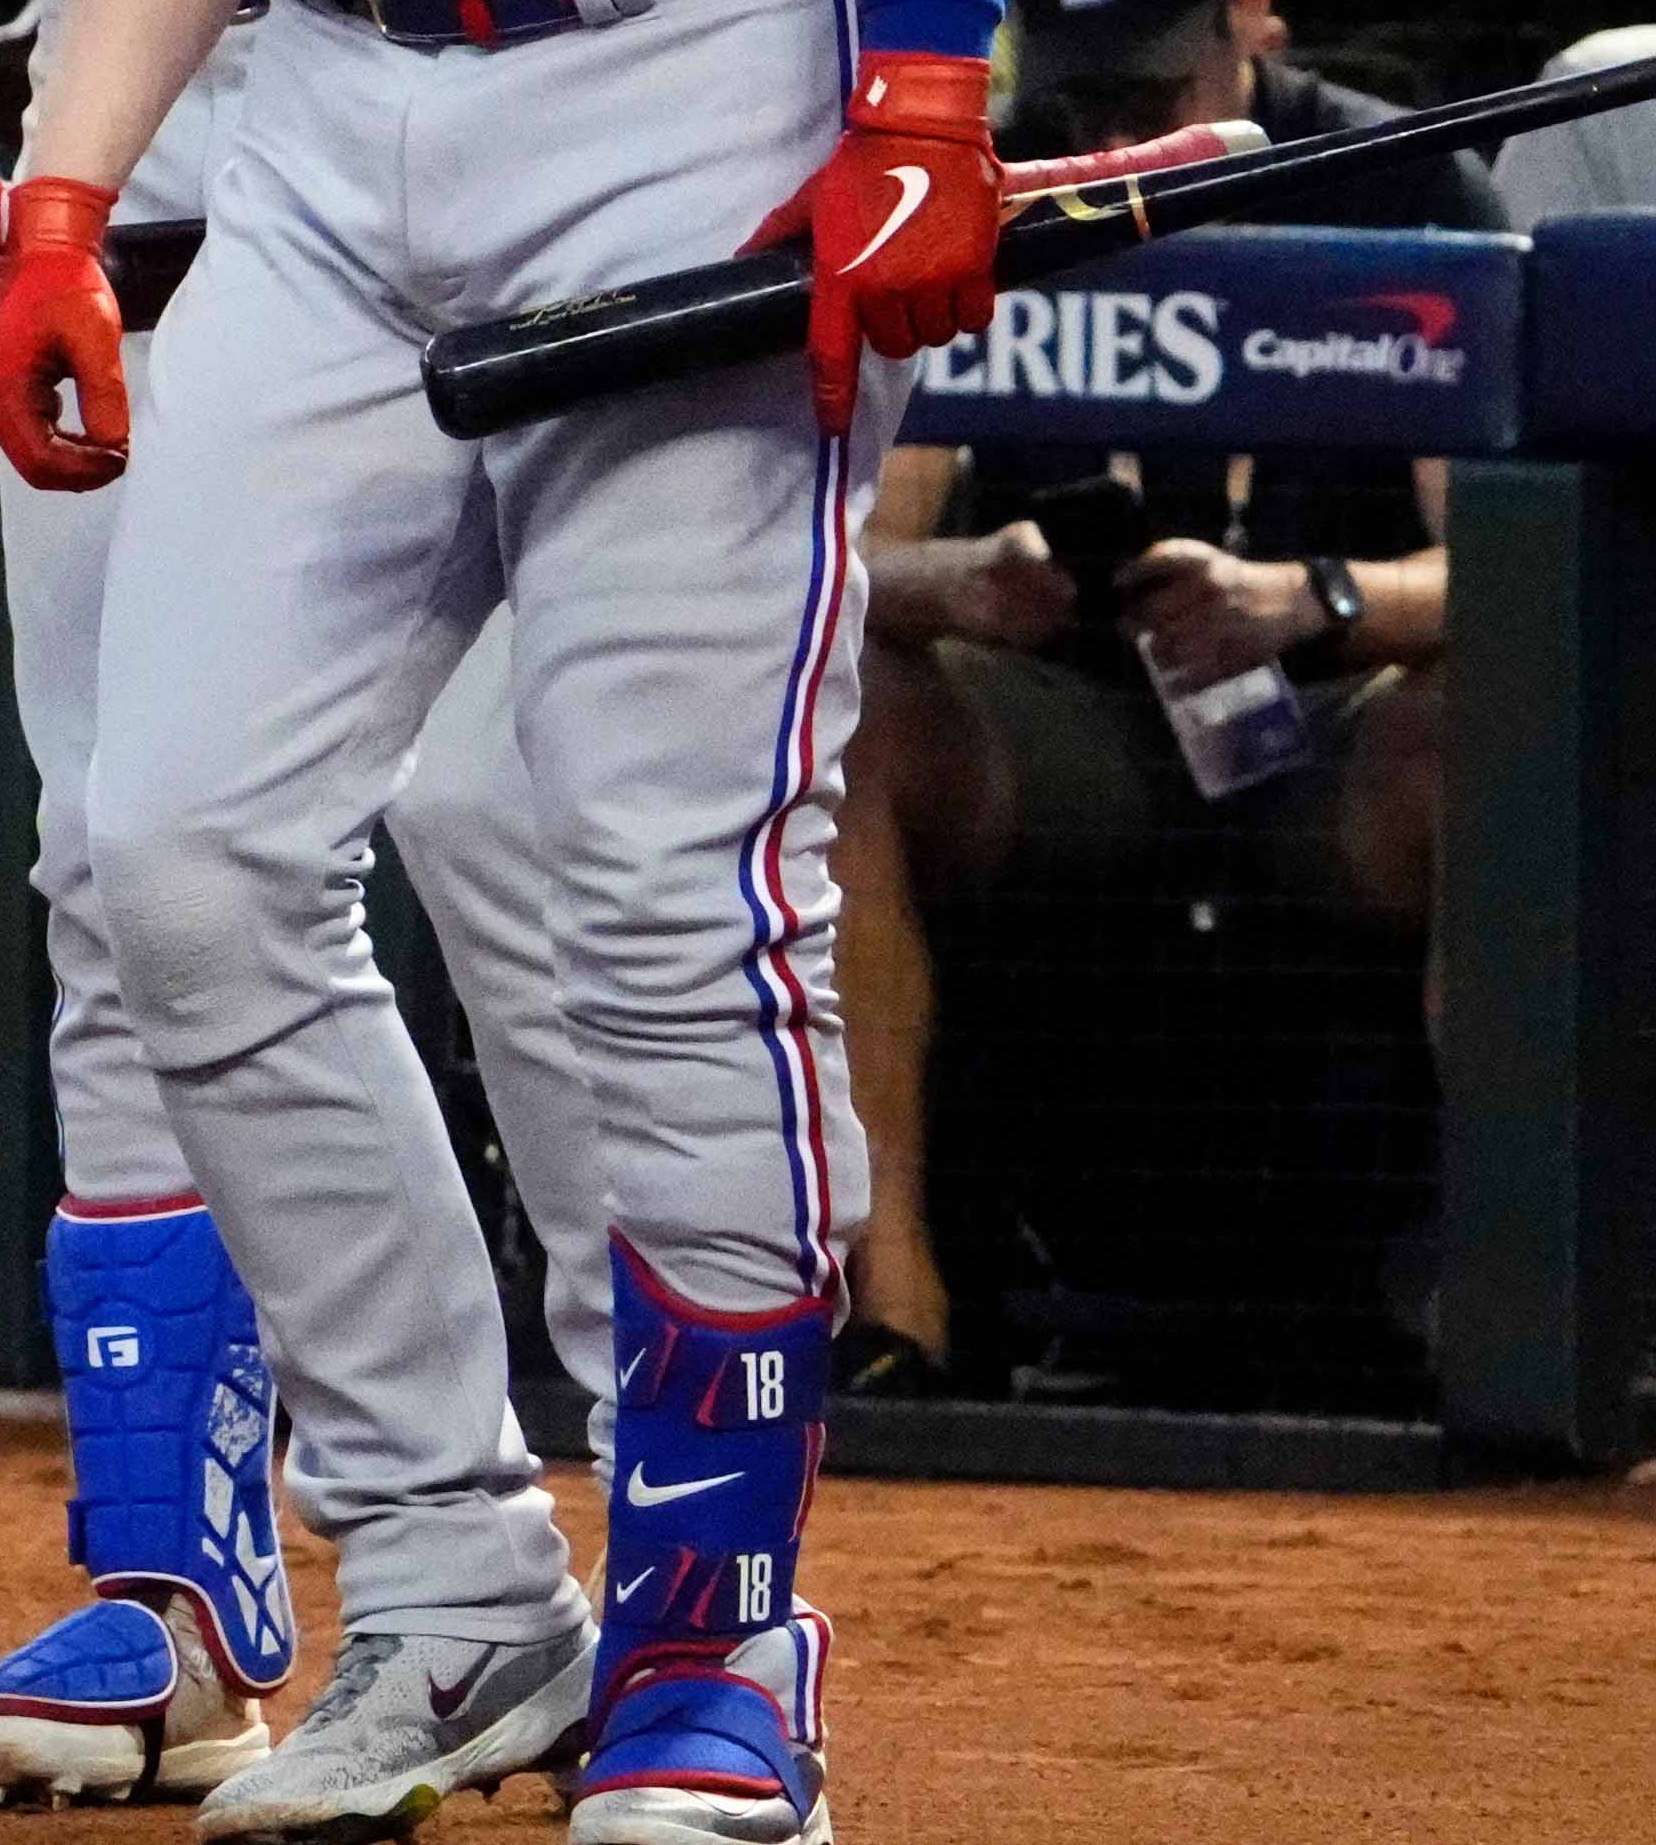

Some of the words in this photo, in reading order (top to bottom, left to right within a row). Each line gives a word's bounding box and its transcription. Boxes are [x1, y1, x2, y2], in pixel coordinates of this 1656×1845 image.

[915, 289, 1225, 405] ERIES
[740, 1350, 785, 1421] 18
[736, 1553, 773, 1622] 18
